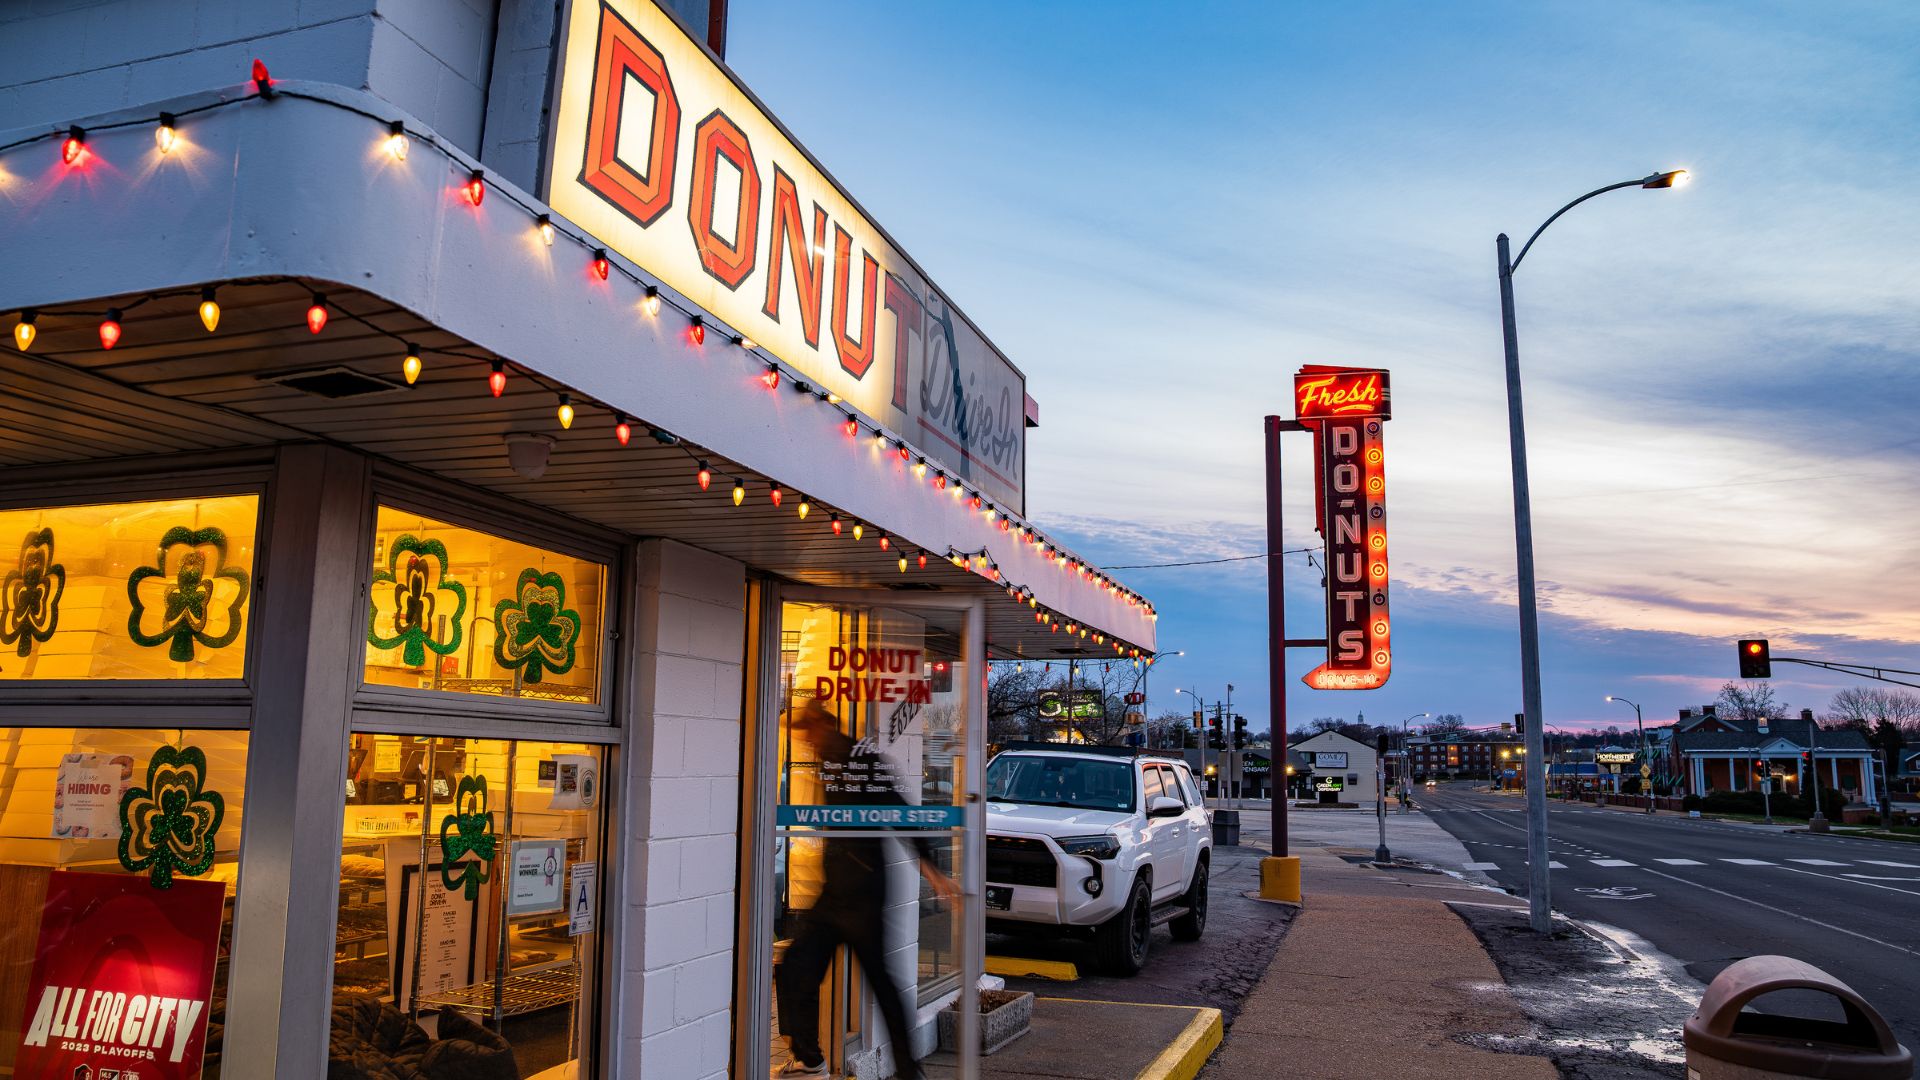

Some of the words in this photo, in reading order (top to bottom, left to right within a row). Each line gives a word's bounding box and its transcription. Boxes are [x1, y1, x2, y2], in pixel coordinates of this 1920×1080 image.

[576, 4, 924, 416] DONUT
[919, 321, 993, 457] Drive
[1298, 374, 1379, 414] Fresh
[828, 646, 920, 673] DONUT
[815, 676, 932, 704] DRIVE-IN
[1318, 674, 1377, 686] DRIVE-IN
[1318, 753, 1344, 761] GOMEZ
[67, 783, 112, 795] HIRING
[795, 809, 852, 823] WATCH
[858, 809, 902, 823] YOUR
[906, 810, 949, 823] STEP
[519, 868, 538, 877] WINNER
[576, 884, 589, 912] A
[23, 985, 88, 1047] ALL
[80, 989, 127, 1044] FOR
[120, 994, 204, 1063] CITY
[60, 1041, 90, 1053] 2023
[93, 1045, 155, 1060] PLAYOFFS
